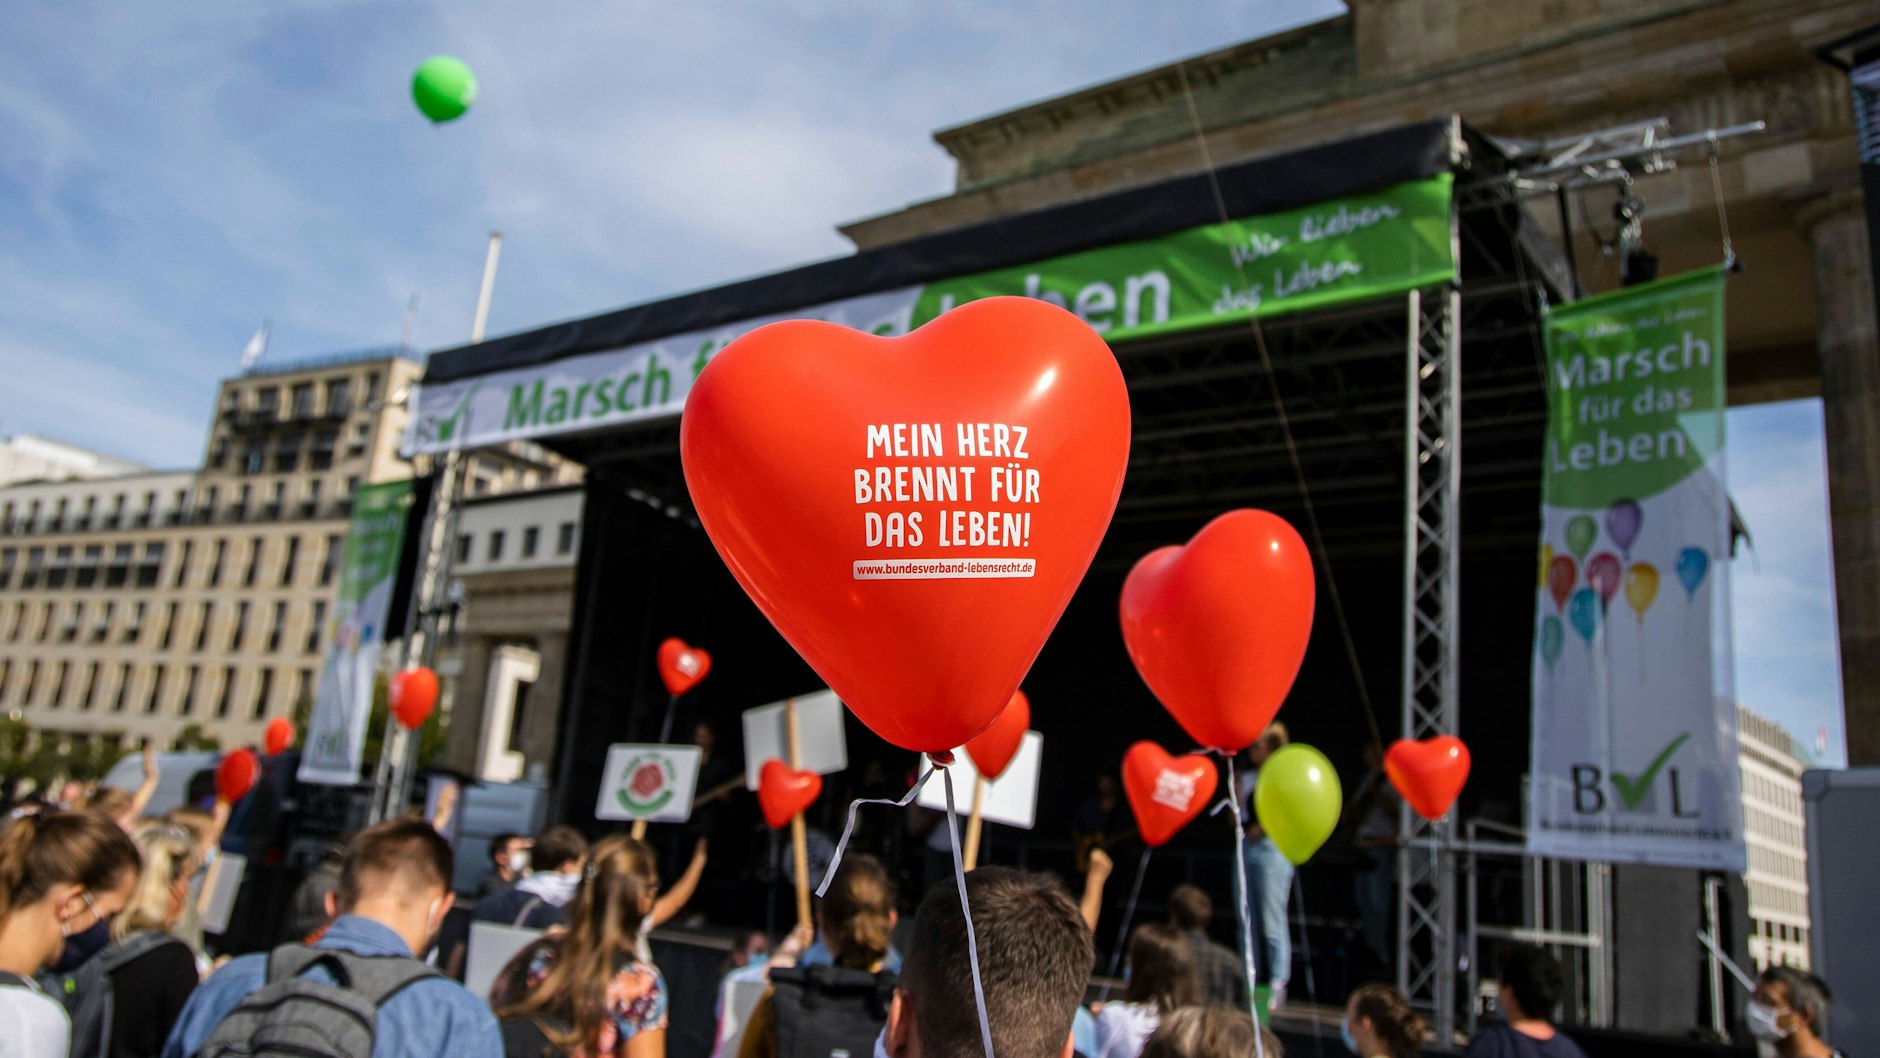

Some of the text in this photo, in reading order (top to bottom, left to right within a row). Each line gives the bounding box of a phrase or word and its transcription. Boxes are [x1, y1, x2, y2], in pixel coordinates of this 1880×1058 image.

[1551, 330, 1712, 391] Marsch
[503, 352, 671, 431] Marsch
[1632, 383, 1695, 416] das
[866, 422, 1029, 459] MEIN HERZ
[1550, 427, 1688, 475] Leben
[853, 462, 1041, 504] BRENNT FÜR
[864, 509, 1031, 548] DAS LEBEN!
[856, 562, 1033, 576] www.bundesverband-lebensrecht.de
